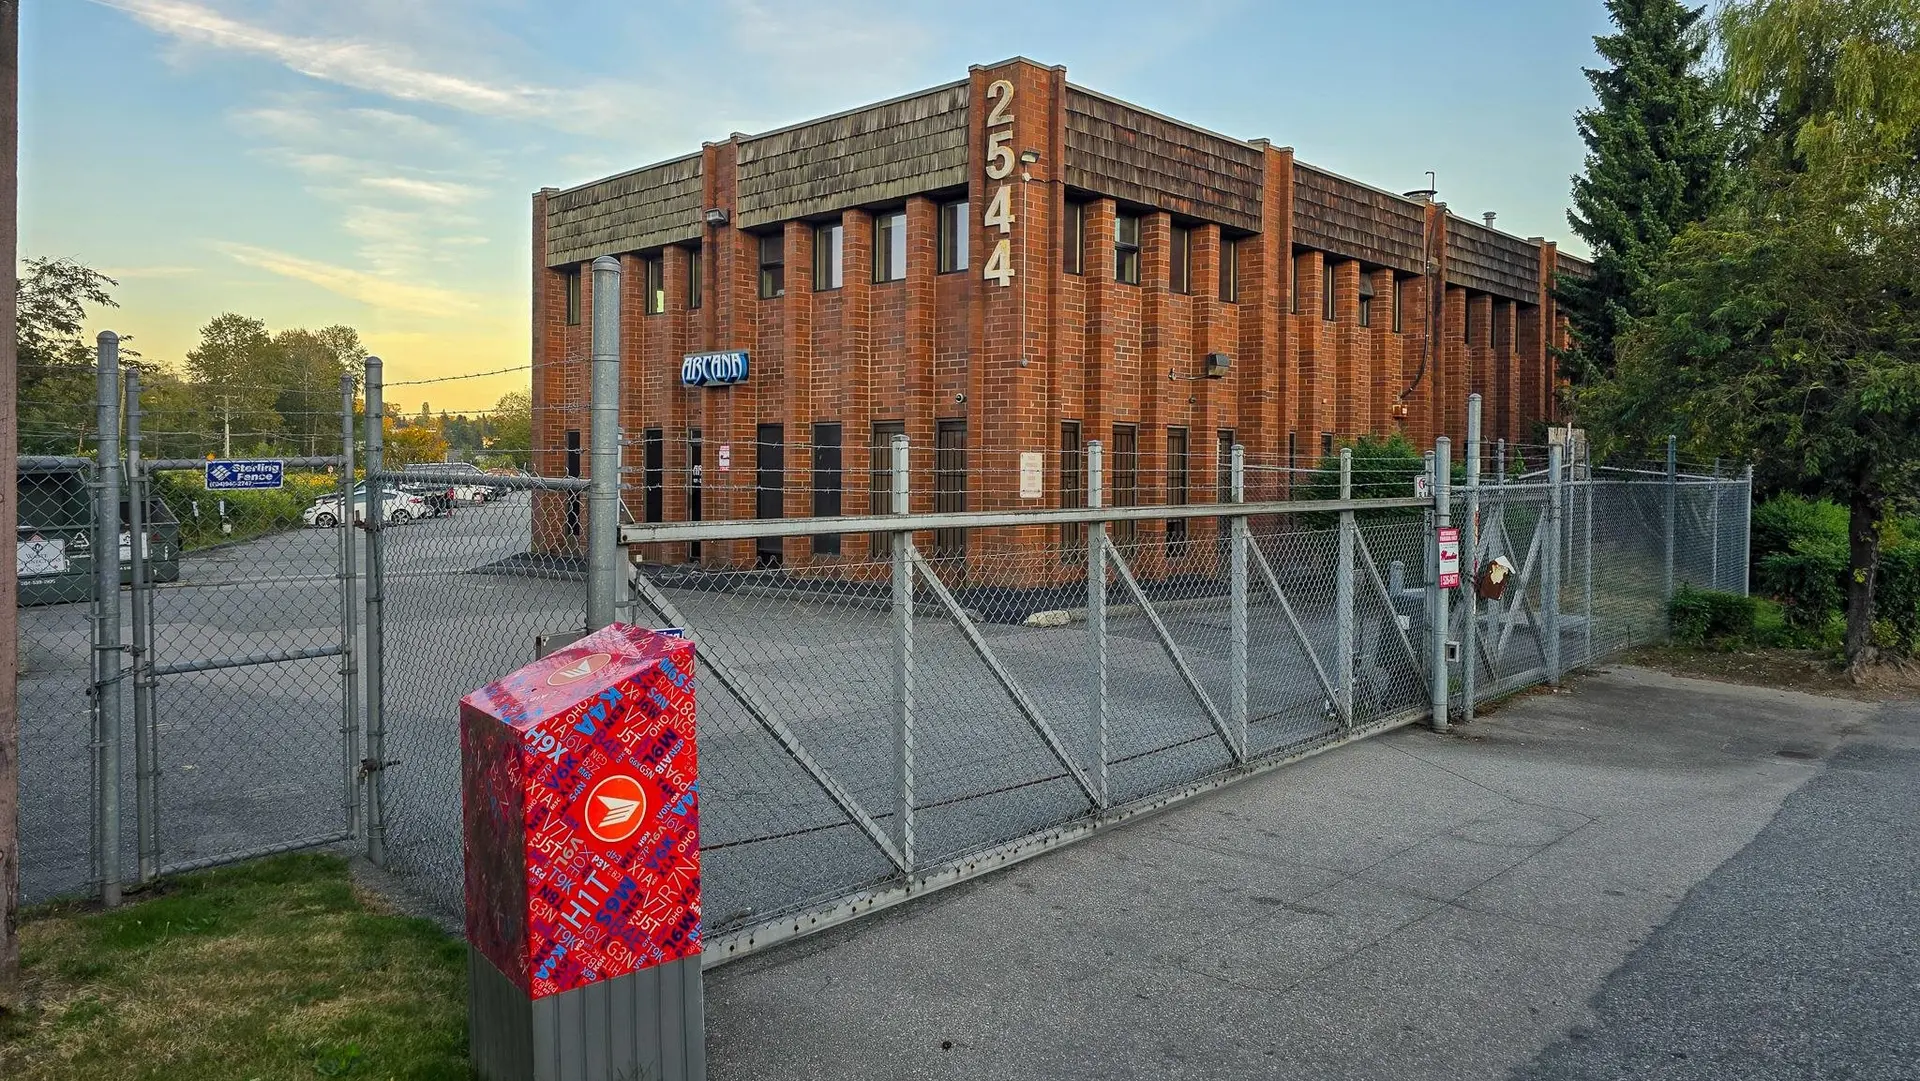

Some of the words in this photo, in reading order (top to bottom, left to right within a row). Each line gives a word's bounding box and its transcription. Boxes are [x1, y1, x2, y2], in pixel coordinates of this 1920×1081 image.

[983, 79, 1016, 288] 2544
[682, 352, 742, 385] ARCANA
[232, 464, 280, 474] Sterling
[659, 657, 688, 686] M6S
[647, 687, 670, 710] S4N
[656, 676, 680, 700] R7N
[574, 686, 623, 735] K4A
[624, 704, 653, 737] V7J
[545, 717, 567, 738] 1A
[560, 730, 589, 753] J6V
[617, 727, 641, 747] J5T
[525, 726, 569, 765] H9X
[545, 754, 578, 788] V6K
[655, 754, 672, 774] A1B
[666, 764, 692, 792] P9A
[525, 779, 554, 808] X1A
[569, 780, 587, 802] S4N
[542, 812, 574, 845] V7J
[536, 836, 562, 858] J5T
[554, 837, 584, 866] V9L
[529, 864, 547, 880] P3Y
[591, 854, 610, 871] P3Y
[627, 860, 652, 887] X1A
[548, 866, 577, 895] T9K
[658, 857, 697, 903] R7N
[529, 897, 558, 923] G3N
[561, 870, 610, 929] H1T
[596, 876, 637, 926] M6S
[643, 890, 673, 921] V7J
[628, 910, 643, 925] Y1A
[636, 914, 661, 934] J5T
[554, 923, 580, 951] T9K
[578, 922, 607, 944] J6V
[534, 944, 567, 979] K4A
[576, 949, 597, 968] B2Z
[607, 940, 637, 969] G3N
[646, 942, 666, 963] T9K
